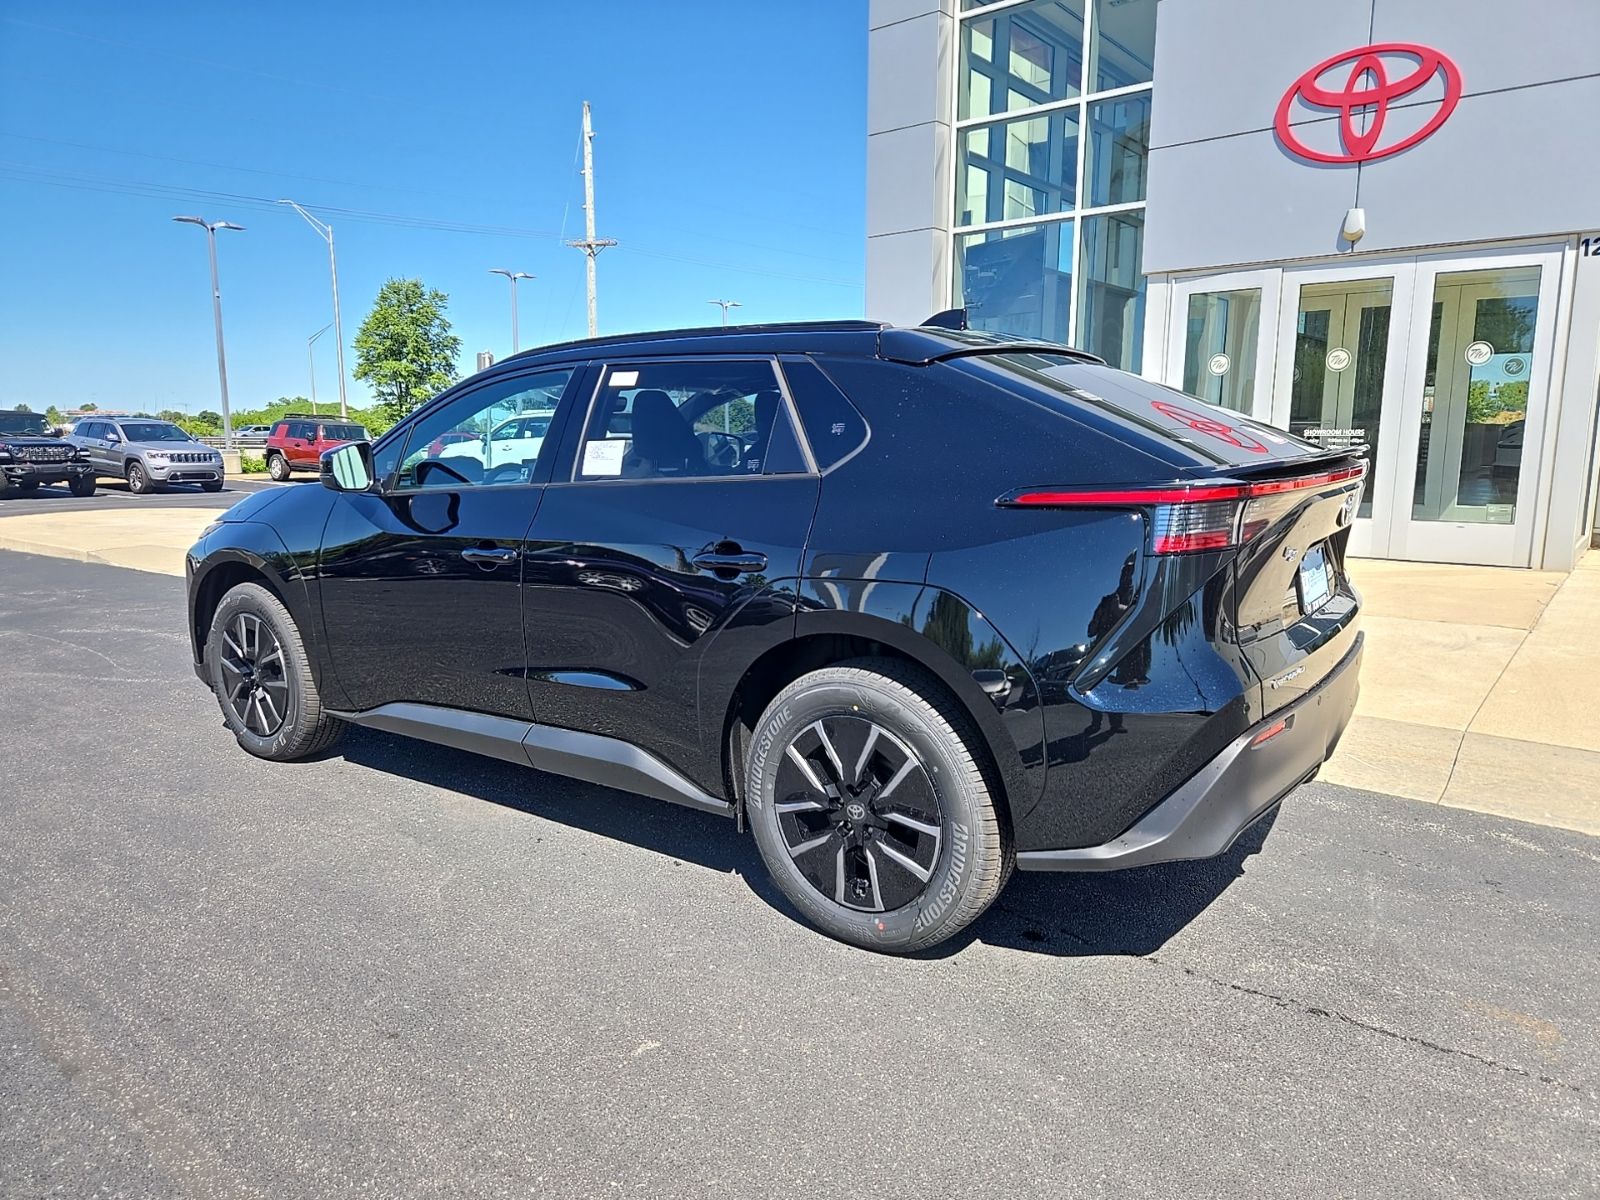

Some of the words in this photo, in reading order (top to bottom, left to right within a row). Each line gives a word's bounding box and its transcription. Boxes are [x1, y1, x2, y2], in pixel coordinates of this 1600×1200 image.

[1303, 428, 1342, 437] SHOWROOM
[1343, 428, 1365, 437] HOURS
[749, 705, 793, 810] BRIDGESTONE
[915, 821, 969, 933] BRIDGESTONE
